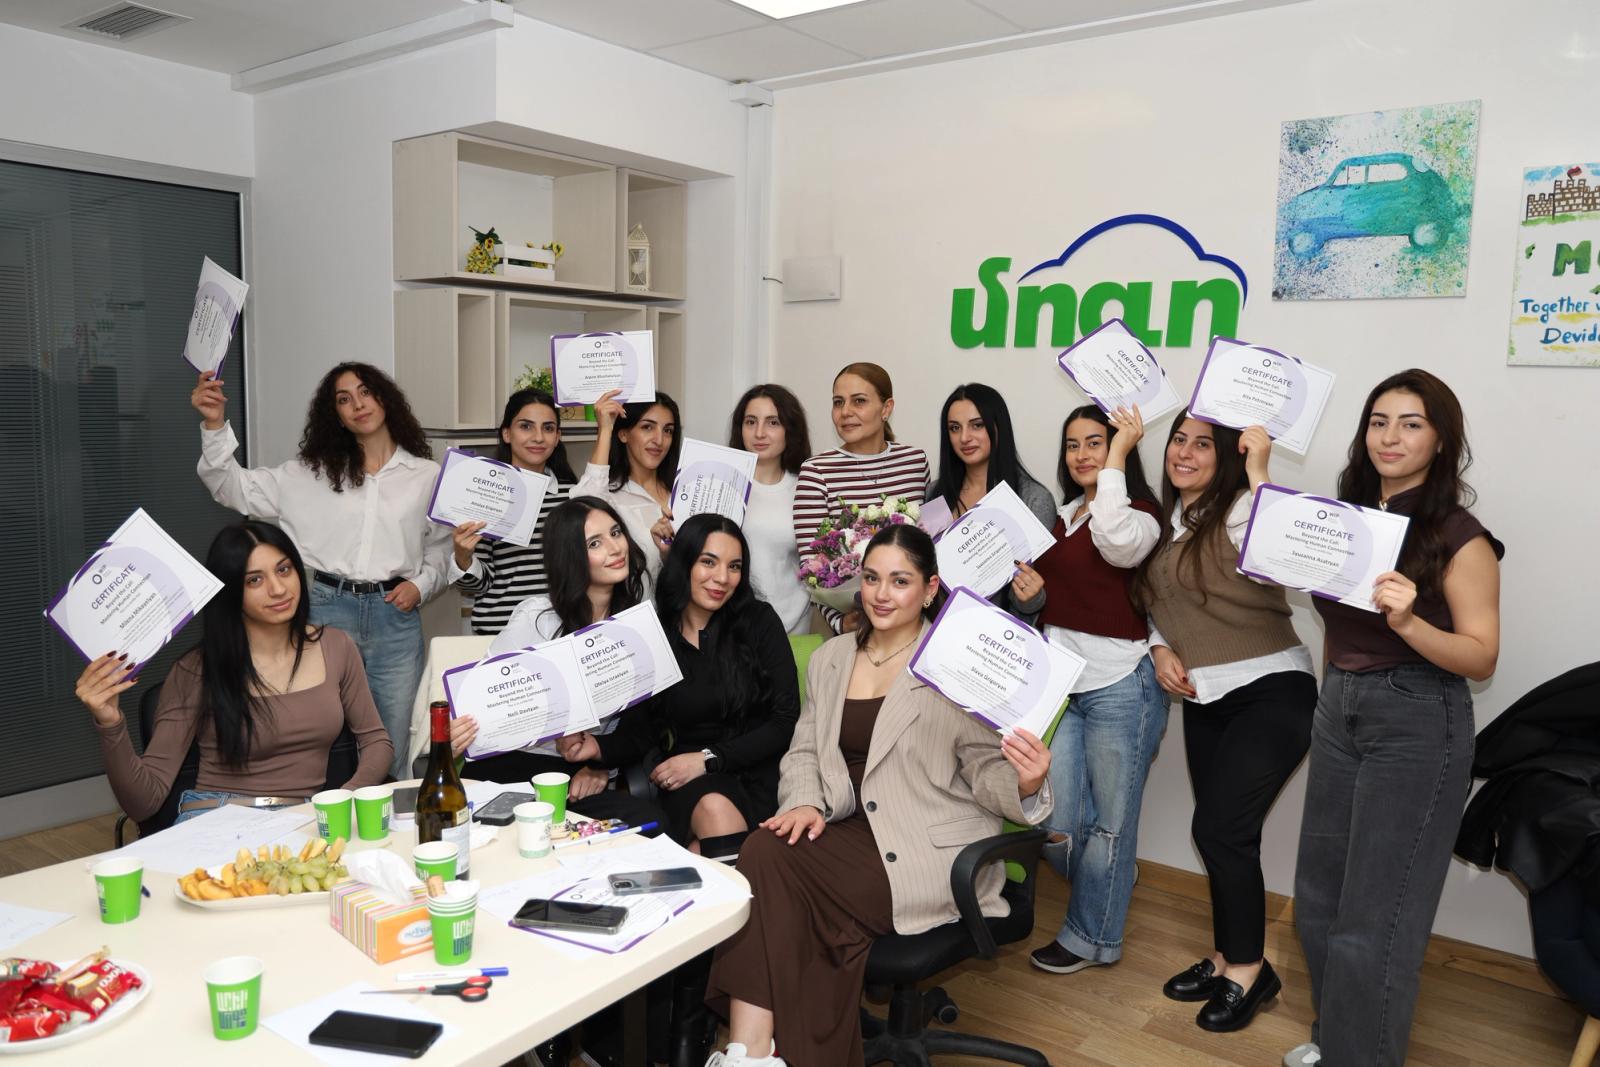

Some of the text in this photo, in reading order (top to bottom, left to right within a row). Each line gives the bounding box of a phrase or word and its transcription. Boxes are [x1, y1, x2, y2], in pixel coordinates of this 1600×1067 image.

[1552, 240, 1600, 276] M
[1519, 296, 1590, 323] Together
[1540, 323, 1600, 344] Devid
[581, 350, 624, 359] CERTIFICATE
[1116, 349, 1150, 385] CERTIFICATE
[1241, 366, 1294, 388] CERTIFICATE
[472, 476, 516, 494] CERTIFICATE
[688, 473, 705, 517] CERTIFICATE
[956, 520, 997, 554] CERTIFICATE
[1293, 519, 1356, 542] CERTIFICATE
[90, 563, 138, 611] CERTIFICATE
[104, 593, 121, 609] Beyond
[579, 640, 627, 665] ERTIFICATE
[977, 633, 1036, 671] CERTIFICATE
[486, 672, 544, 695] CERTIFICATE
